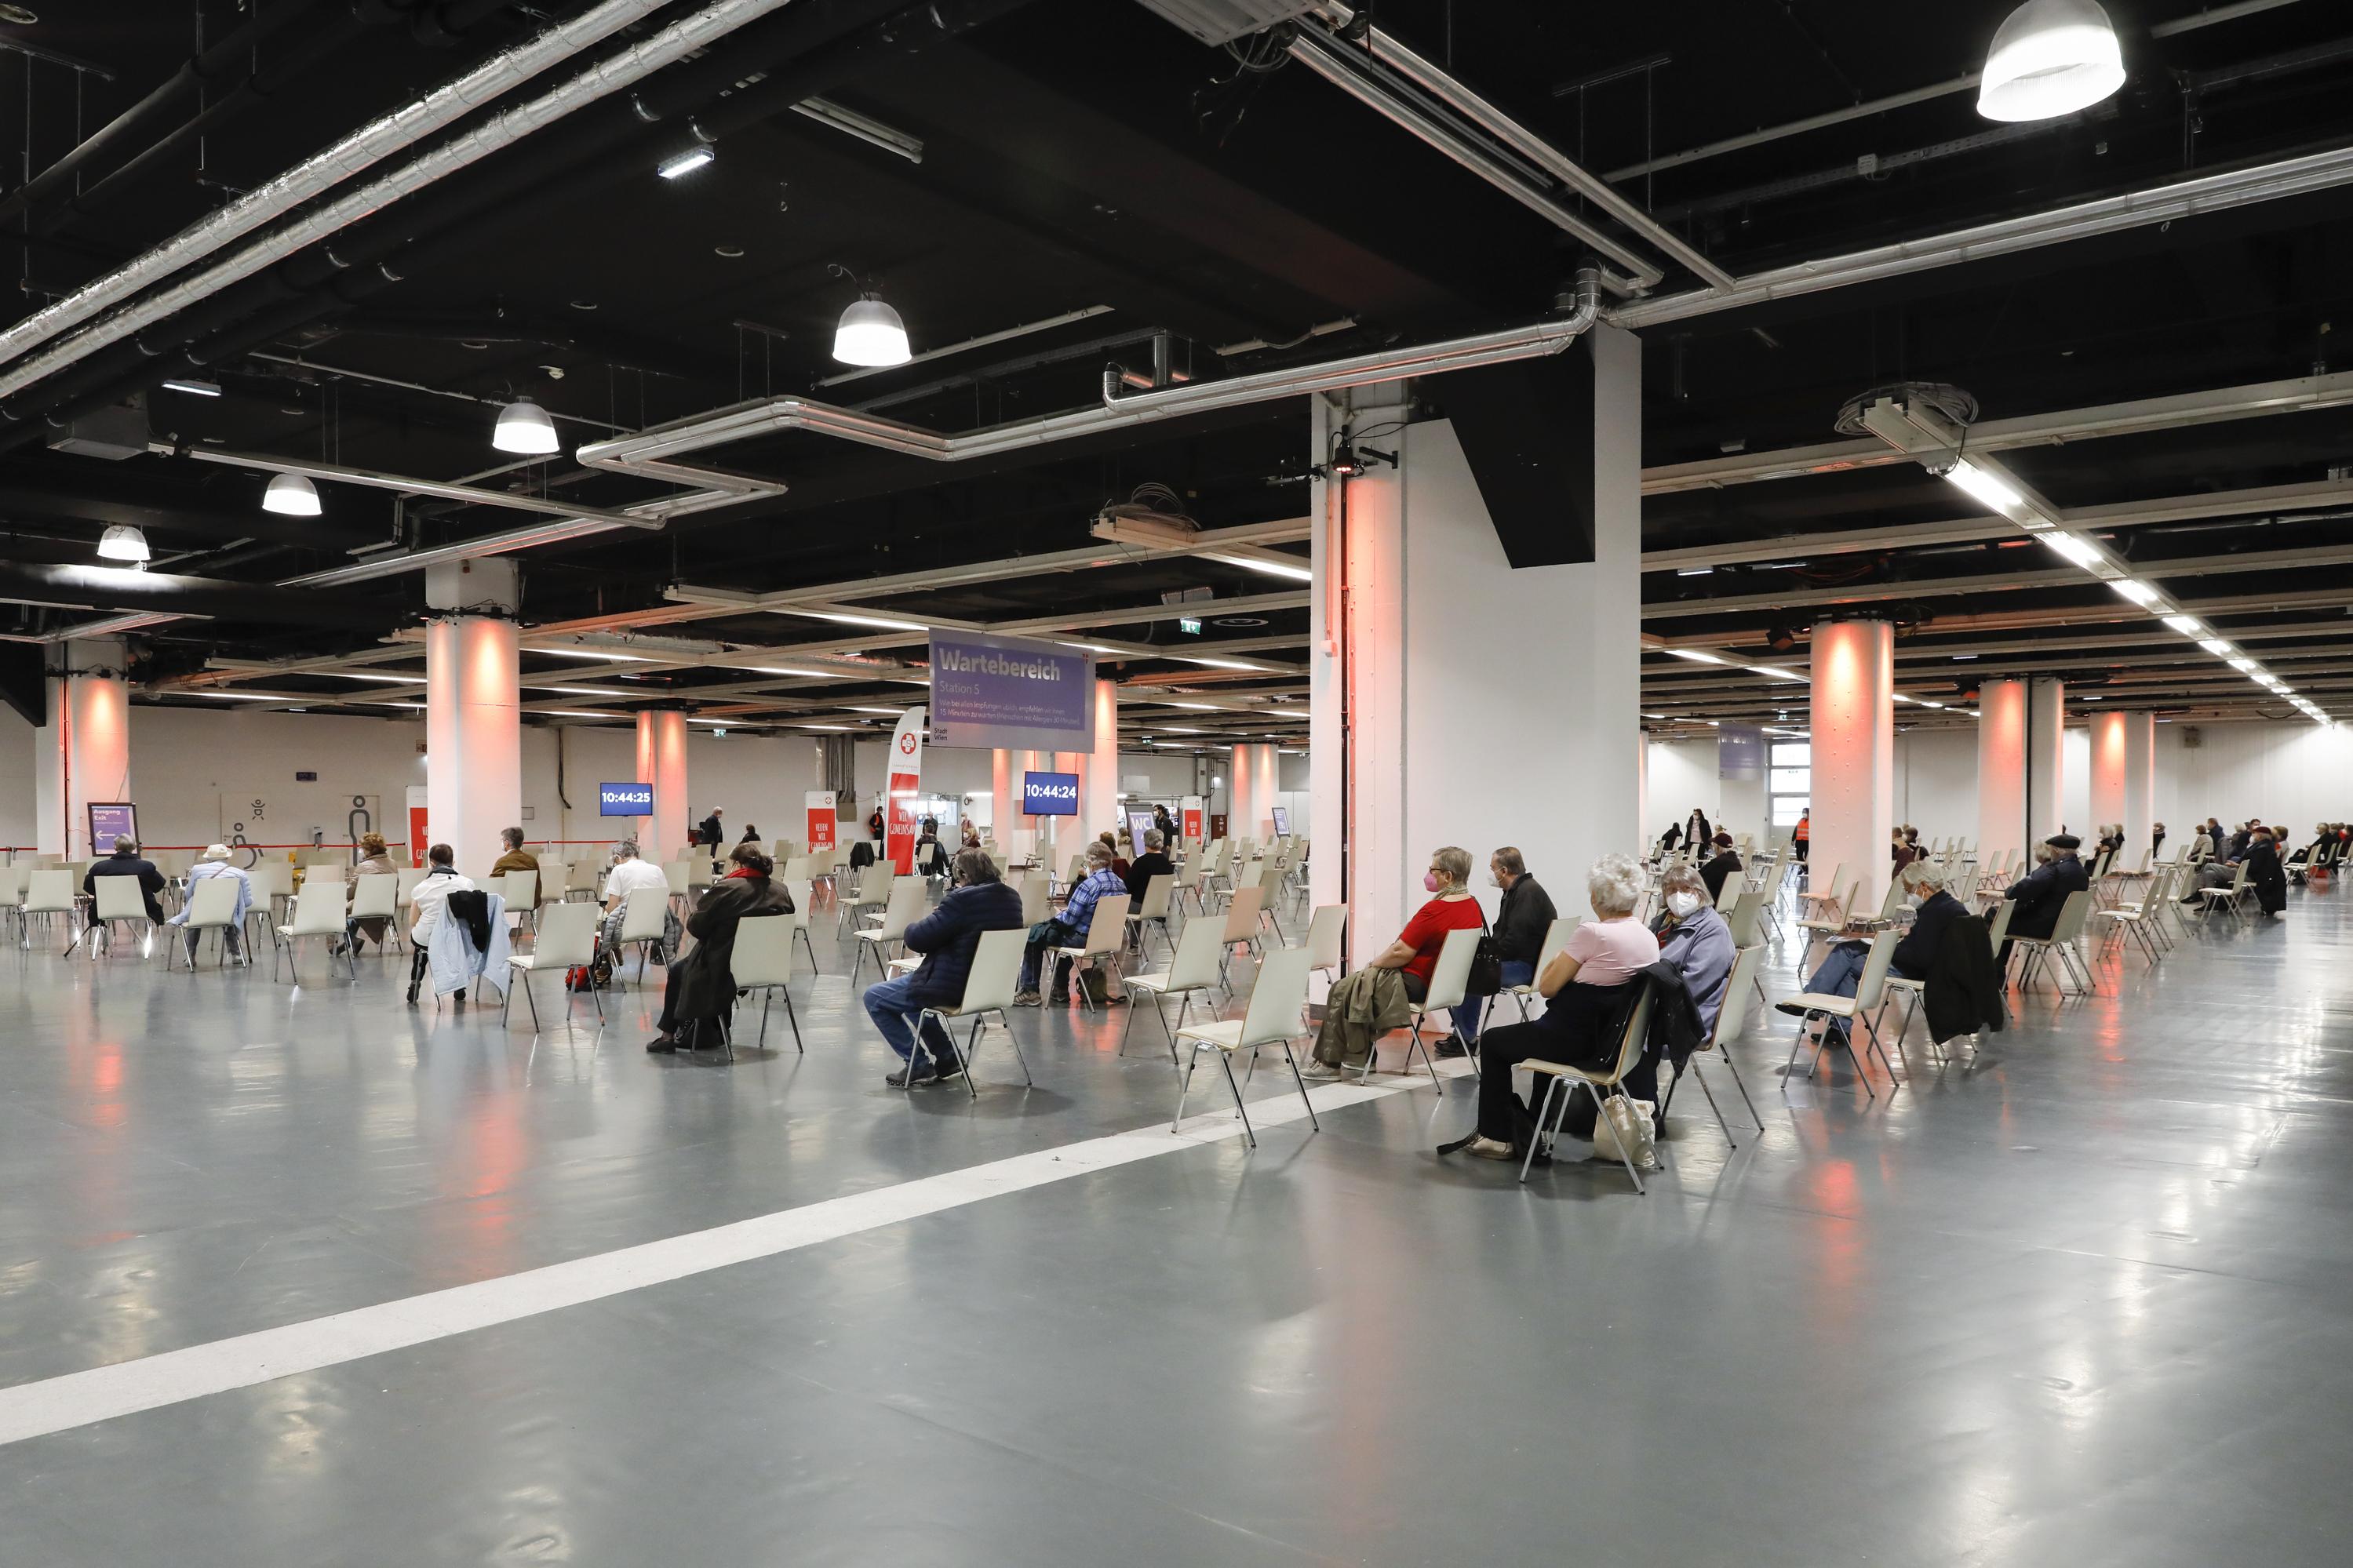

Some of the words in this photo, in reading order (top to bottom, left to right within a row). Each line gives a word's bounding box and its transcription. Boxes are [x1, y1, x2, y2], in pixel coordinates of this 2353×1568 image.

[939, 648, 1060, 681] Wartebereich
[939, 681, 972, 694] Station
[974, 684, 980, 695] 5
[974, 701, 1001, 711] Impfungen
[1033, 715, 1052, 724] Allergien
[601, 792, 650, 802] 10:44:25
[1025, 784, 1076, 799] 10:44:24
[898, 811, 907, 821] WIR
[1131, 817, 1151, 830] WC
